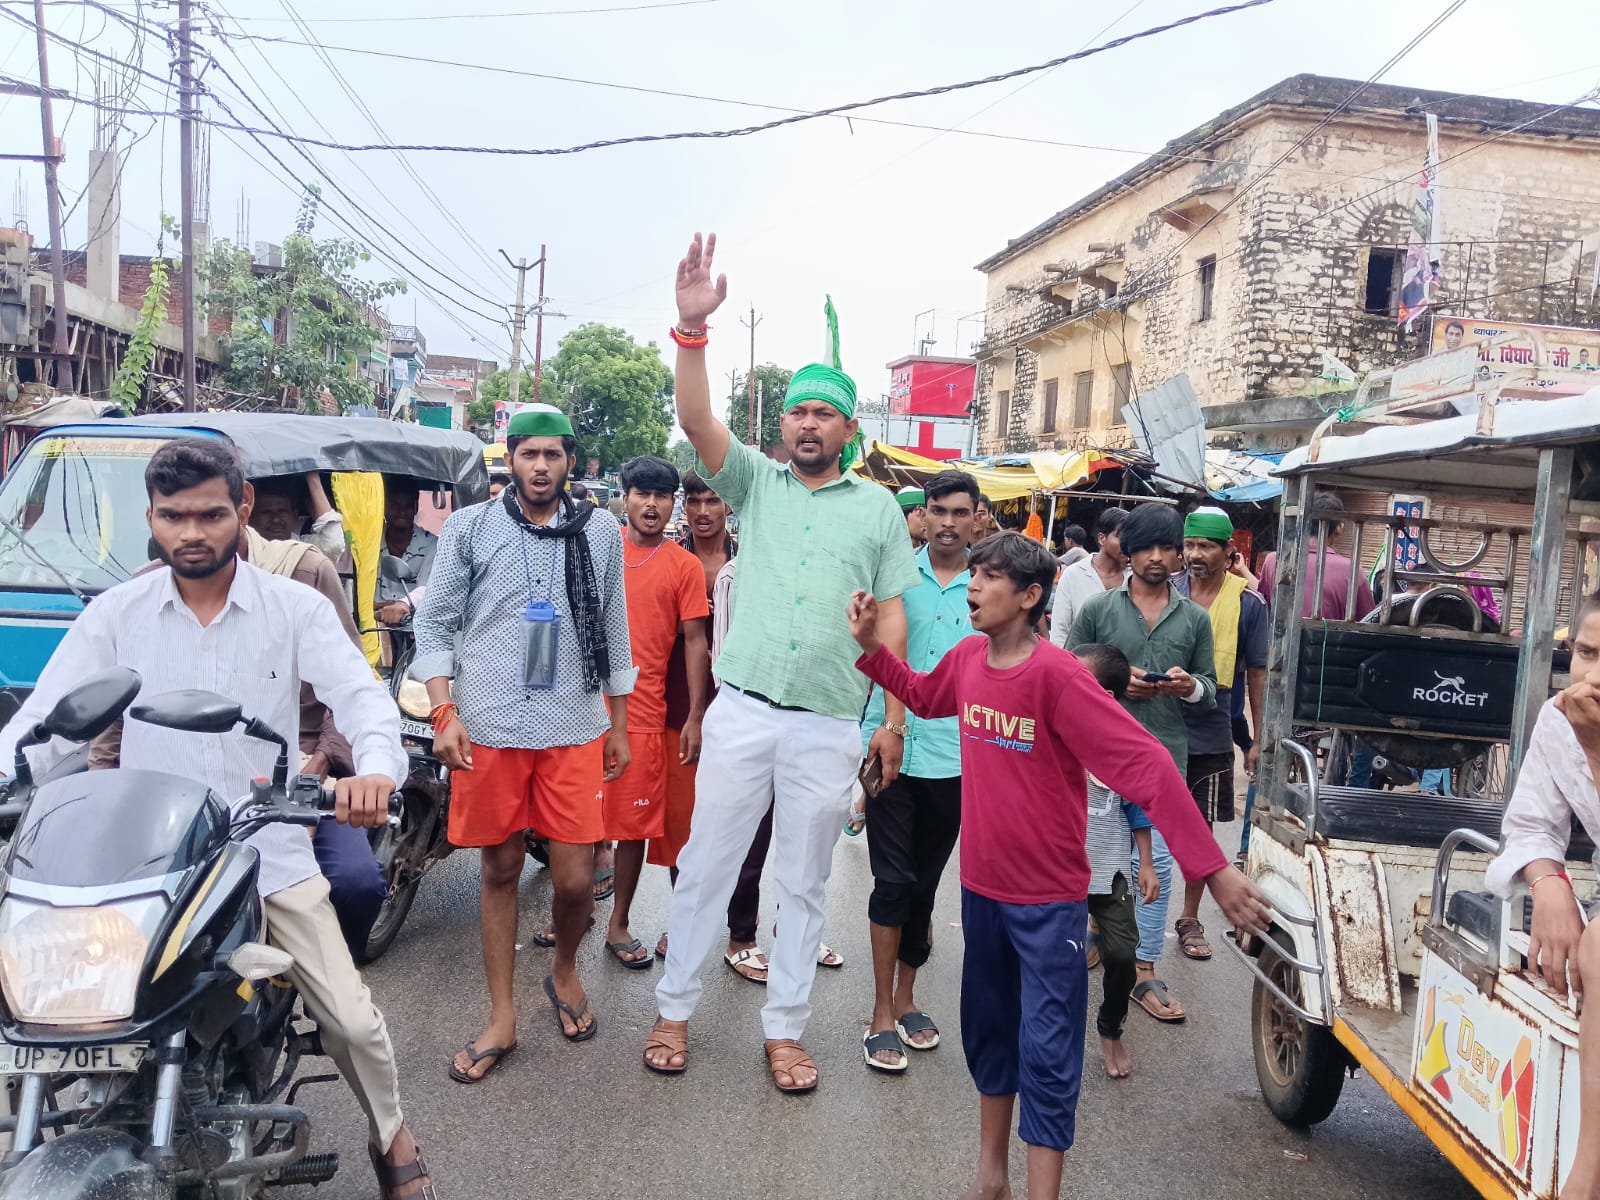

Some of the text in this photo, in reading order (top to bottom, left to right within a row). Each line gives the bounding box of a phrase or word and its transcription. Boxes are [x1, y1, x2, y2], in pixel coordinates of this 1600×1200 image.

[1412, 687, 1488, 707] ROCKET
[963, 701, 1035, 740] ACTIVE
[14, 1047, 45, 1070] UP
[58, 1046, 122, 1070] 70FL
